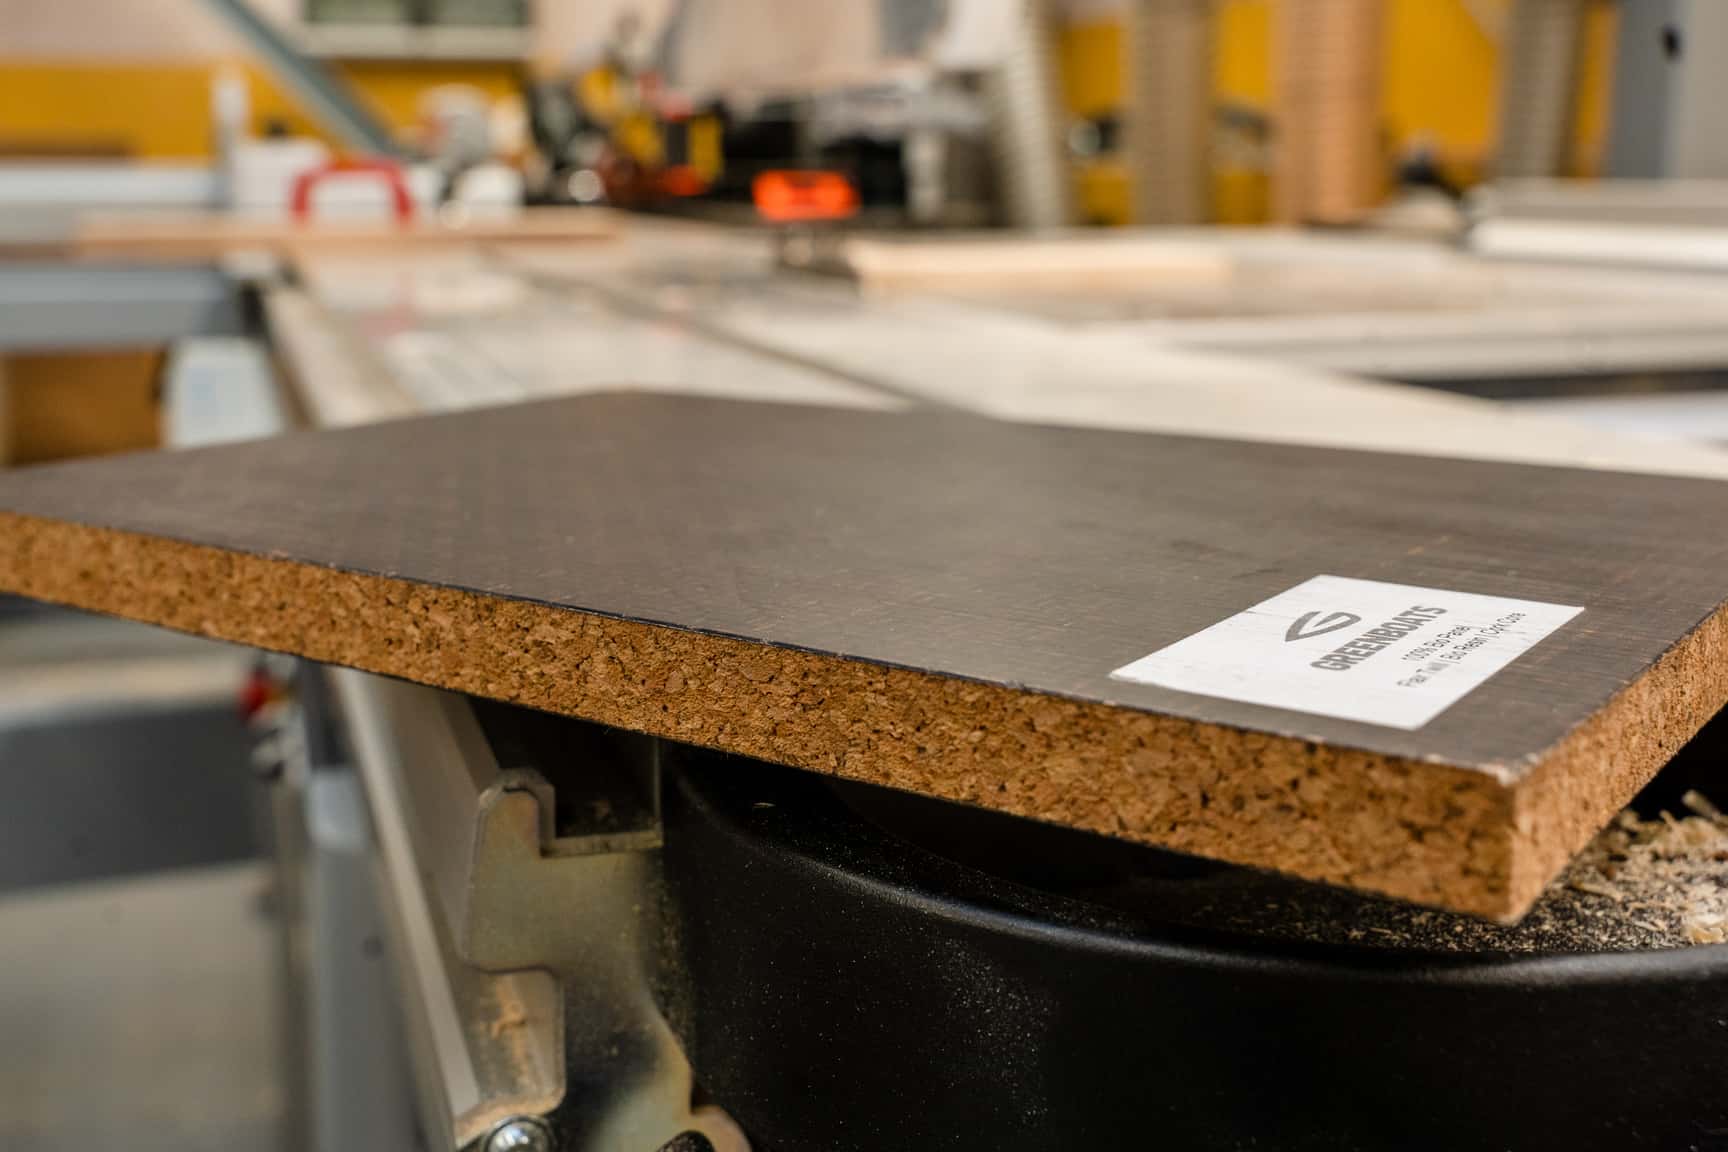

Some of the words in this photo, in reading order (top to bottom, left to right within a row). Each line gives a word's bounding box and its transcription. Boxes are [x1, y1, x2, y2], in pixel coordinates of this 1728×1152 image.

[1310, 606, 1448, 671] GREENBOATS
[1401, 647, 1438, 661] 100%
[1436, 624, 1471, 639] Panel
[1453, 637, 1488, 651] Resin
[1480, 622, 1512, 634] Cork
[1496, 612, 1526, 624] Core
